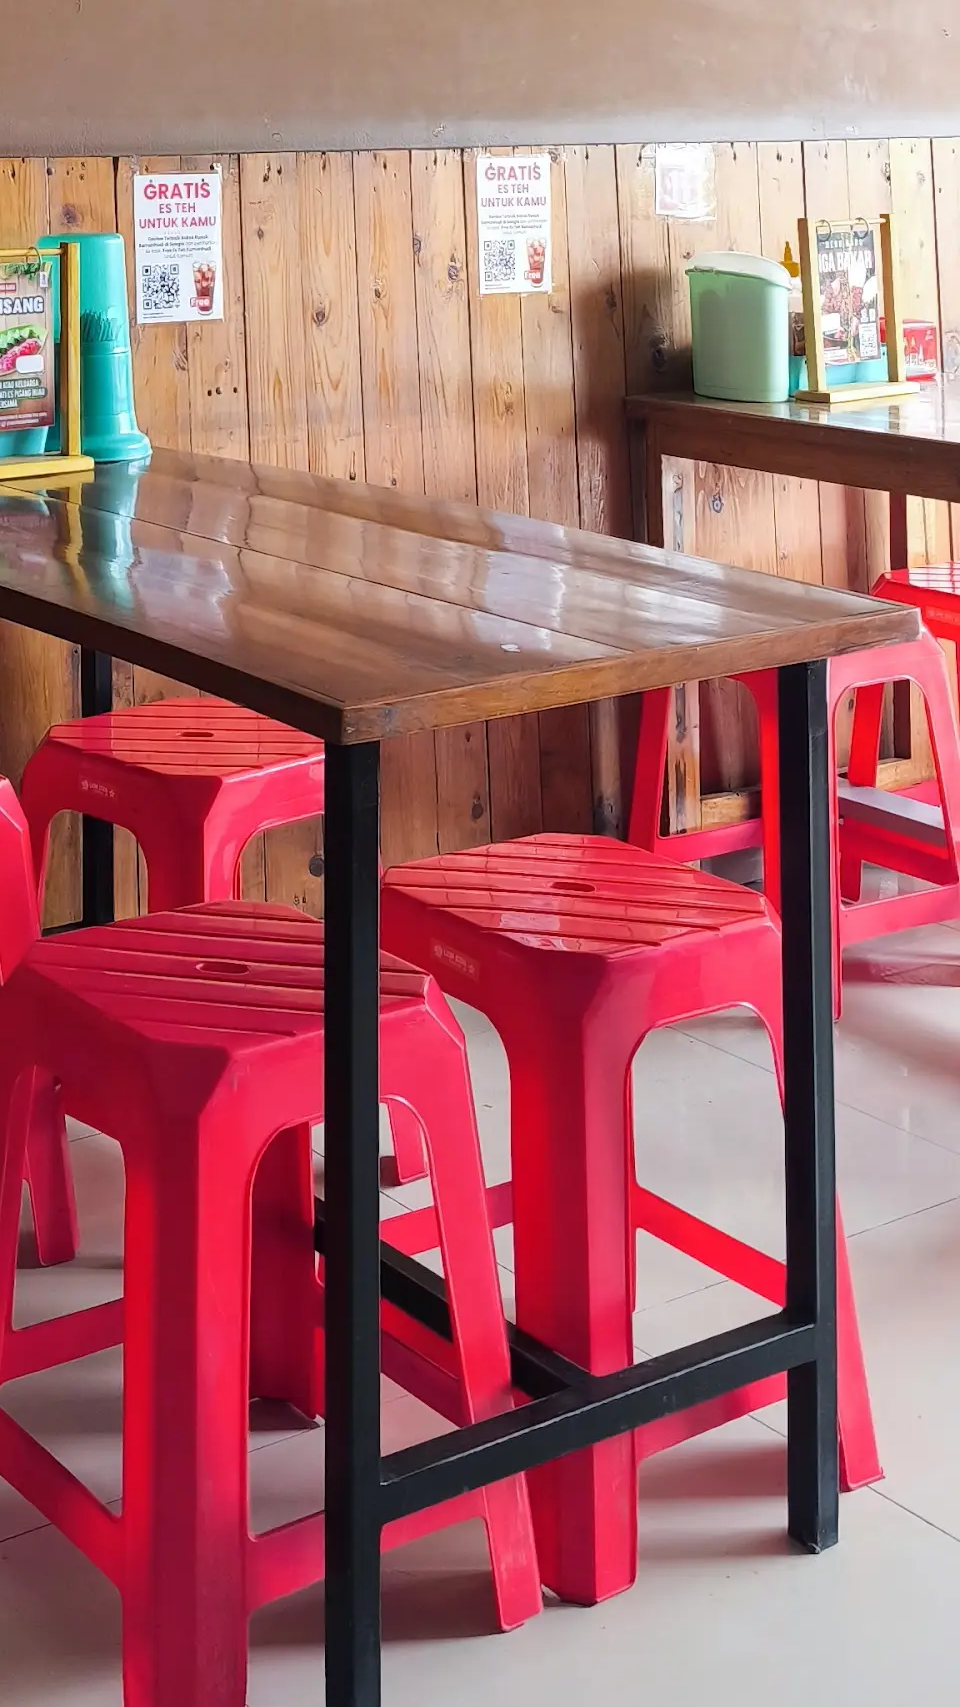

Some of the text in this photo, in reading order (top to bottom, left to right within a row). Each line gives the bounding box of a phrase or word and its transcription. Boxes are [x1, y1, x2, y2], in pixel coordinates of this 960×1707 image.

[484, 165, 541, 181] GRATIS
[143, 181, 211, 200] GRATIS
[497, 183, 529, 194] ES TEH
[159, 202, 196, 214] ES TEH
[481, 196, 547, 208] UNTUK KAMU
[138, 215, 217, 229] UNTUK KAMU
